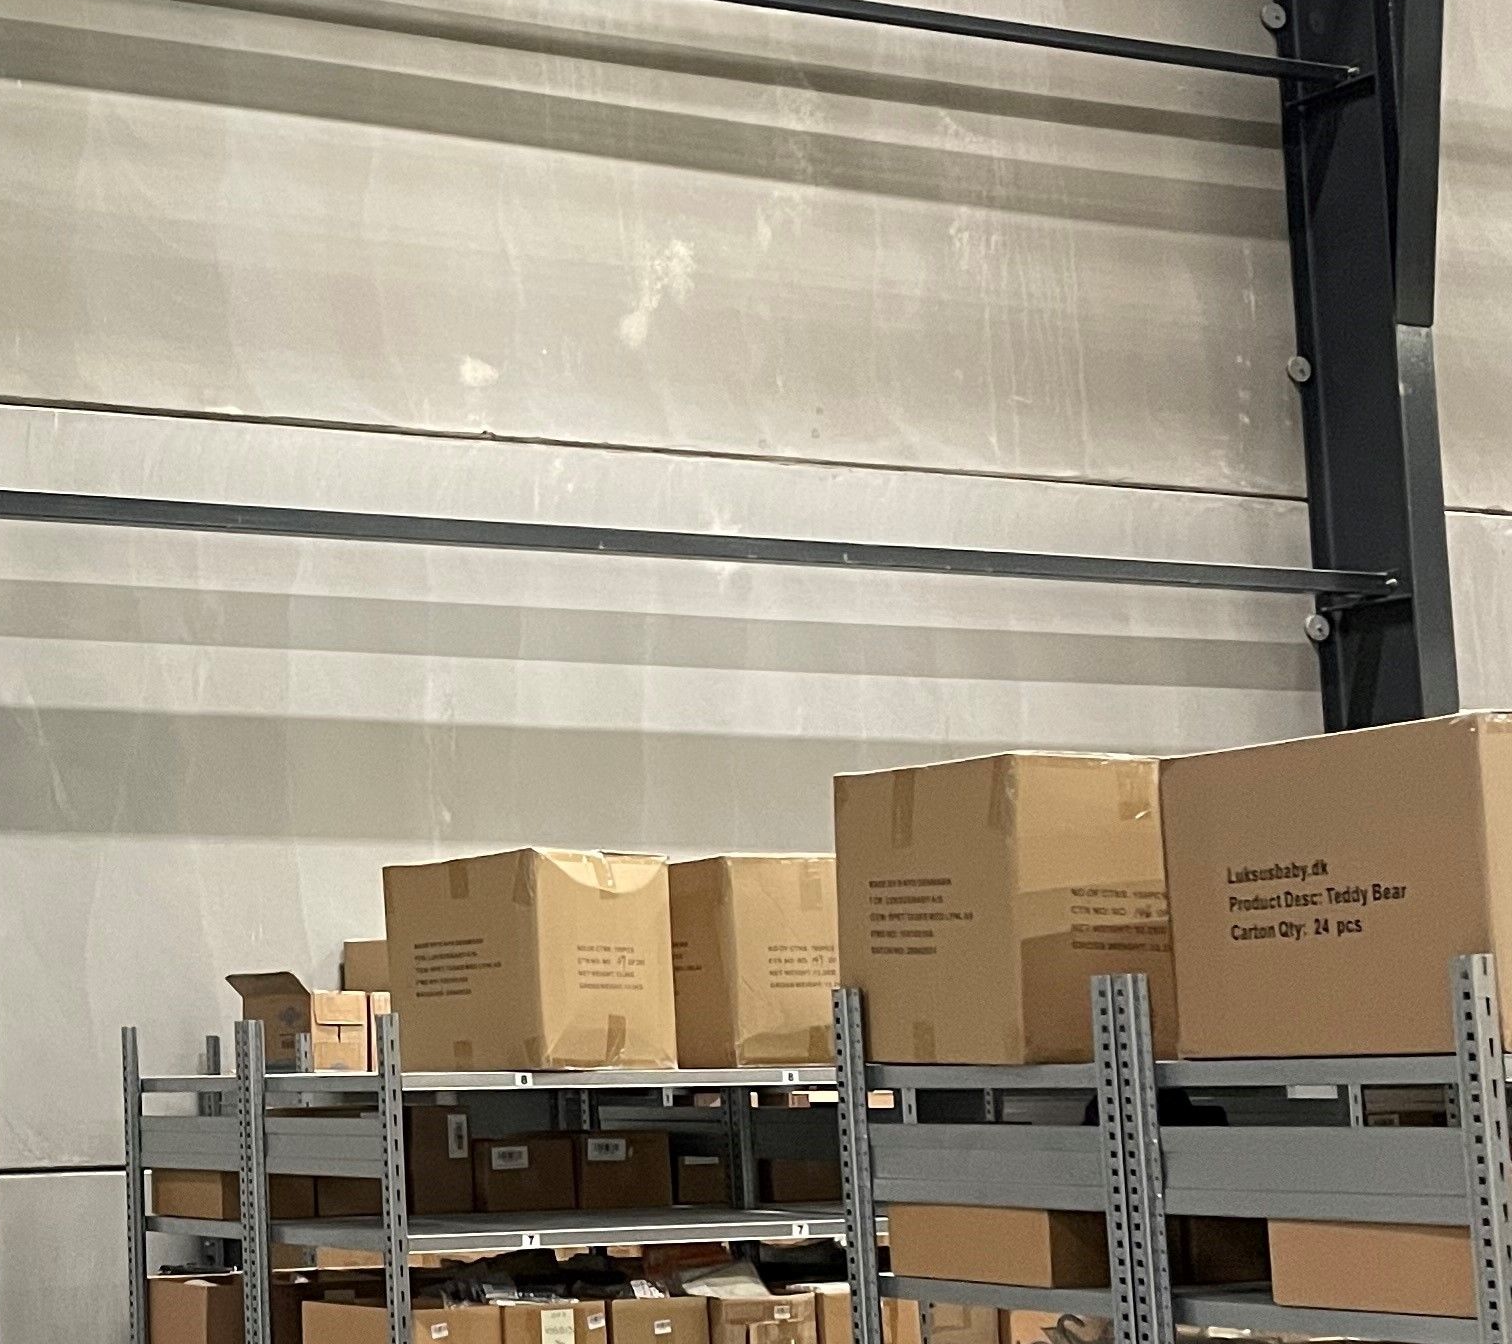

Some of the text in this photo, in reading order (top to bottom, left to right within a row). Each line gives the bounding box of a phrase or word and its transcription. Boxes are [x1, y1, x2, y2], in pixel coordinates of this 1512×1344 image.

[1227, 859, 1329, 884] Luksusbaby.dk
[1229, 895, 1281, 912] Product
[1325, 885, 1368, 906] Teddy
[1372, 883, 1407, 902] Bear
[1231, 918, 1363, 941] Carton Qty: 24 pcs
[521, 1075, 528, 1084] 8
[798, 1225, 804, 1234] 7
[528, 1235, 535, 1245] 7
